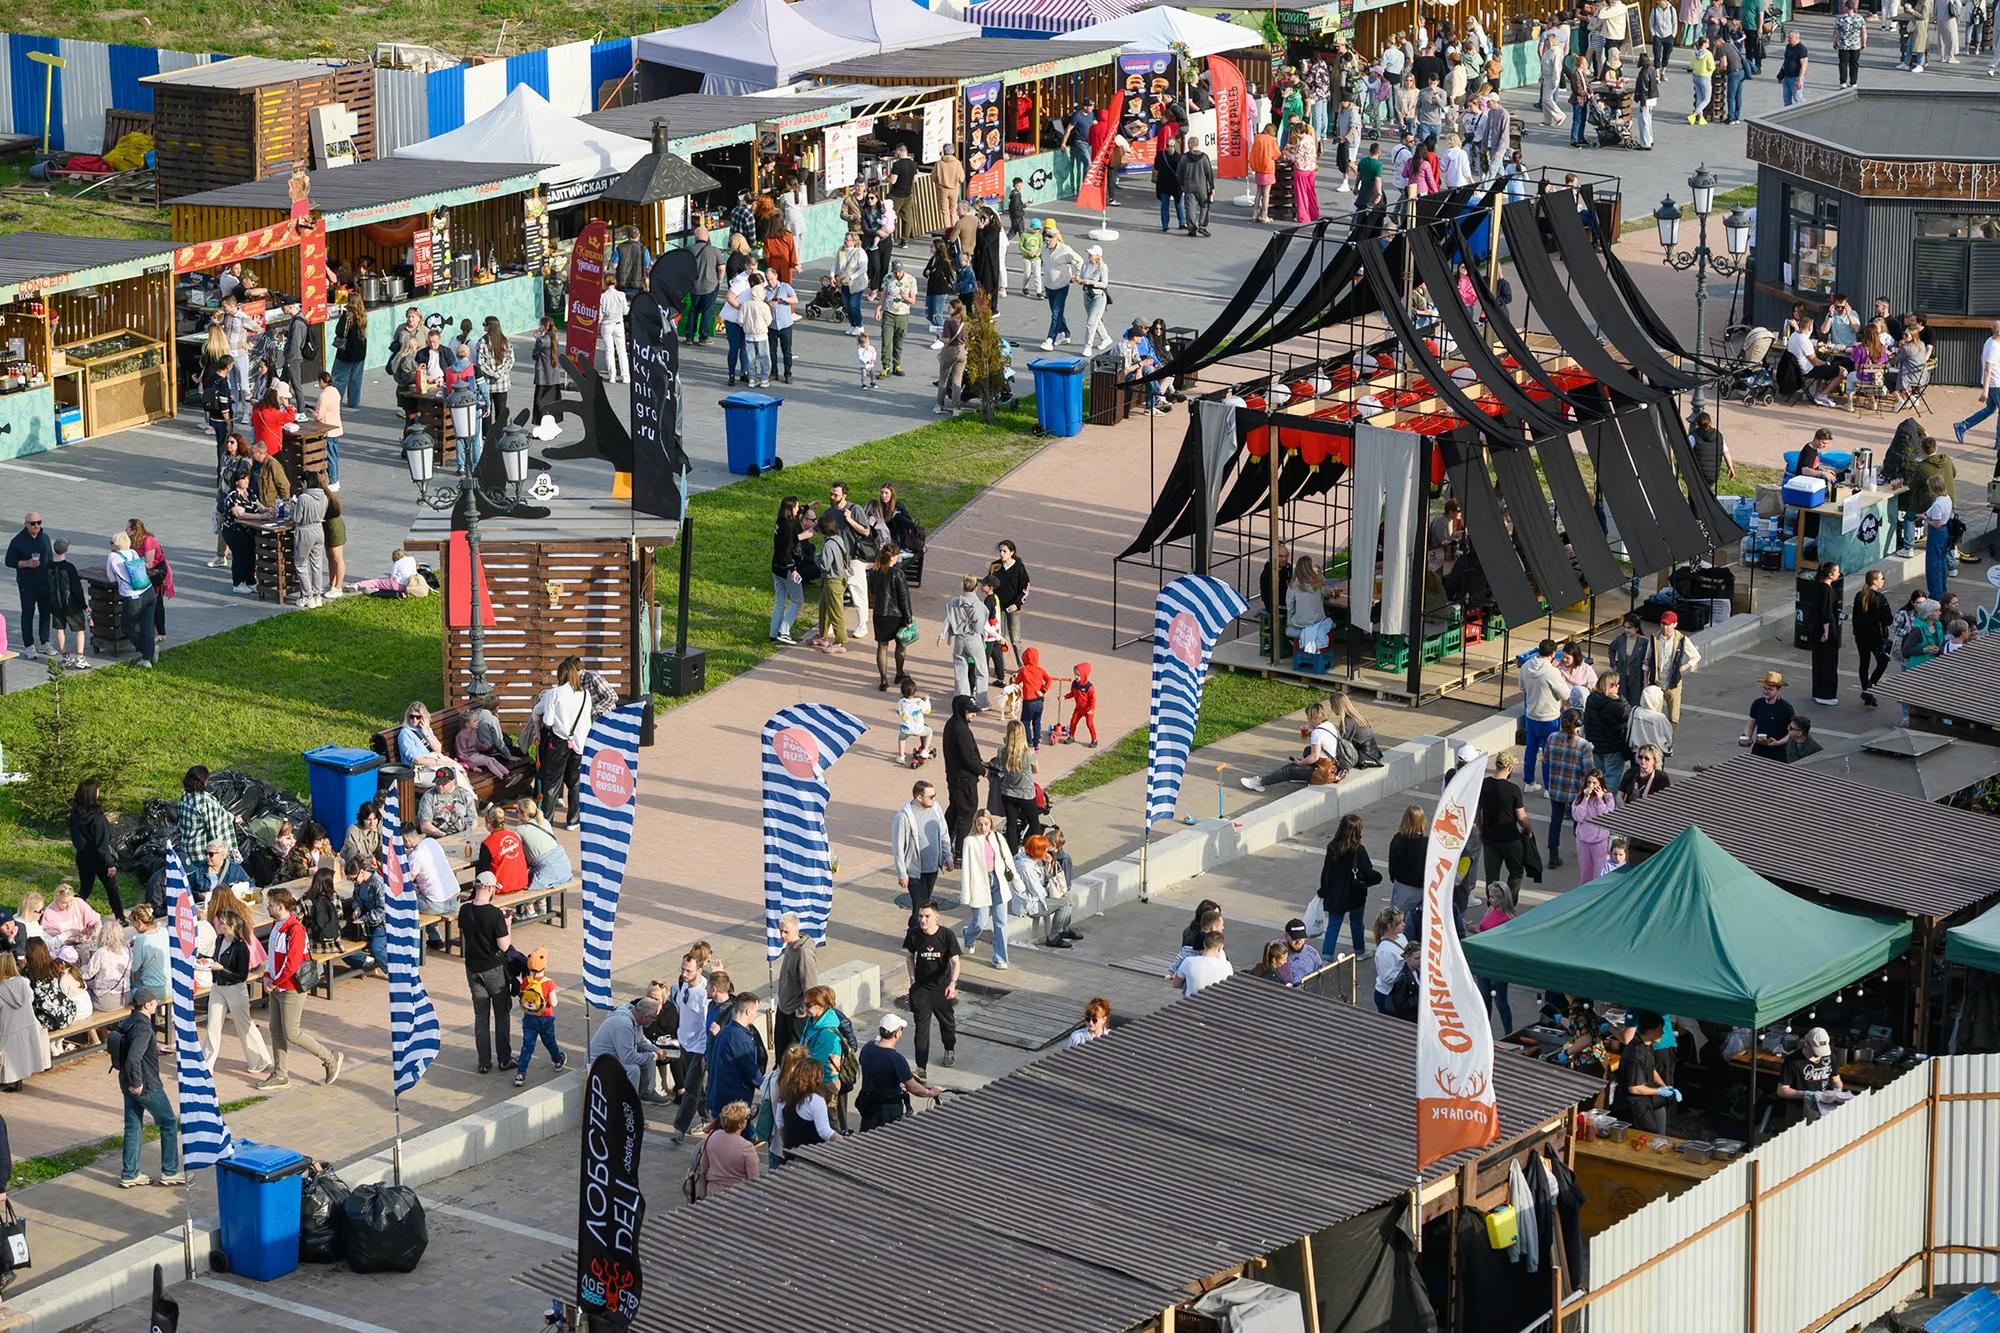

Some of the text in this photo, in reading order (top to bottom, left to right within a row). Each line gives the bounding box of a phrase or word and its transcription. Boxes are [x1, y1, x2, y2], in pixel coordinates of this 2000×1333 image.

[1278, 11, 1309, 24] МОХИТО
[19, 271, 71, 292] CONCEPT
[596, 760, 625, 775] STREET
[596, 770, 617, 783] FOOD
[596, 781, 626, 795] RUSSIA
[586, 1074, 609, 1248] ЛОБСТЕР
[613, 1178, 640, 1254] DELI
[581, 1273, 605, 1295] ЛОБ
